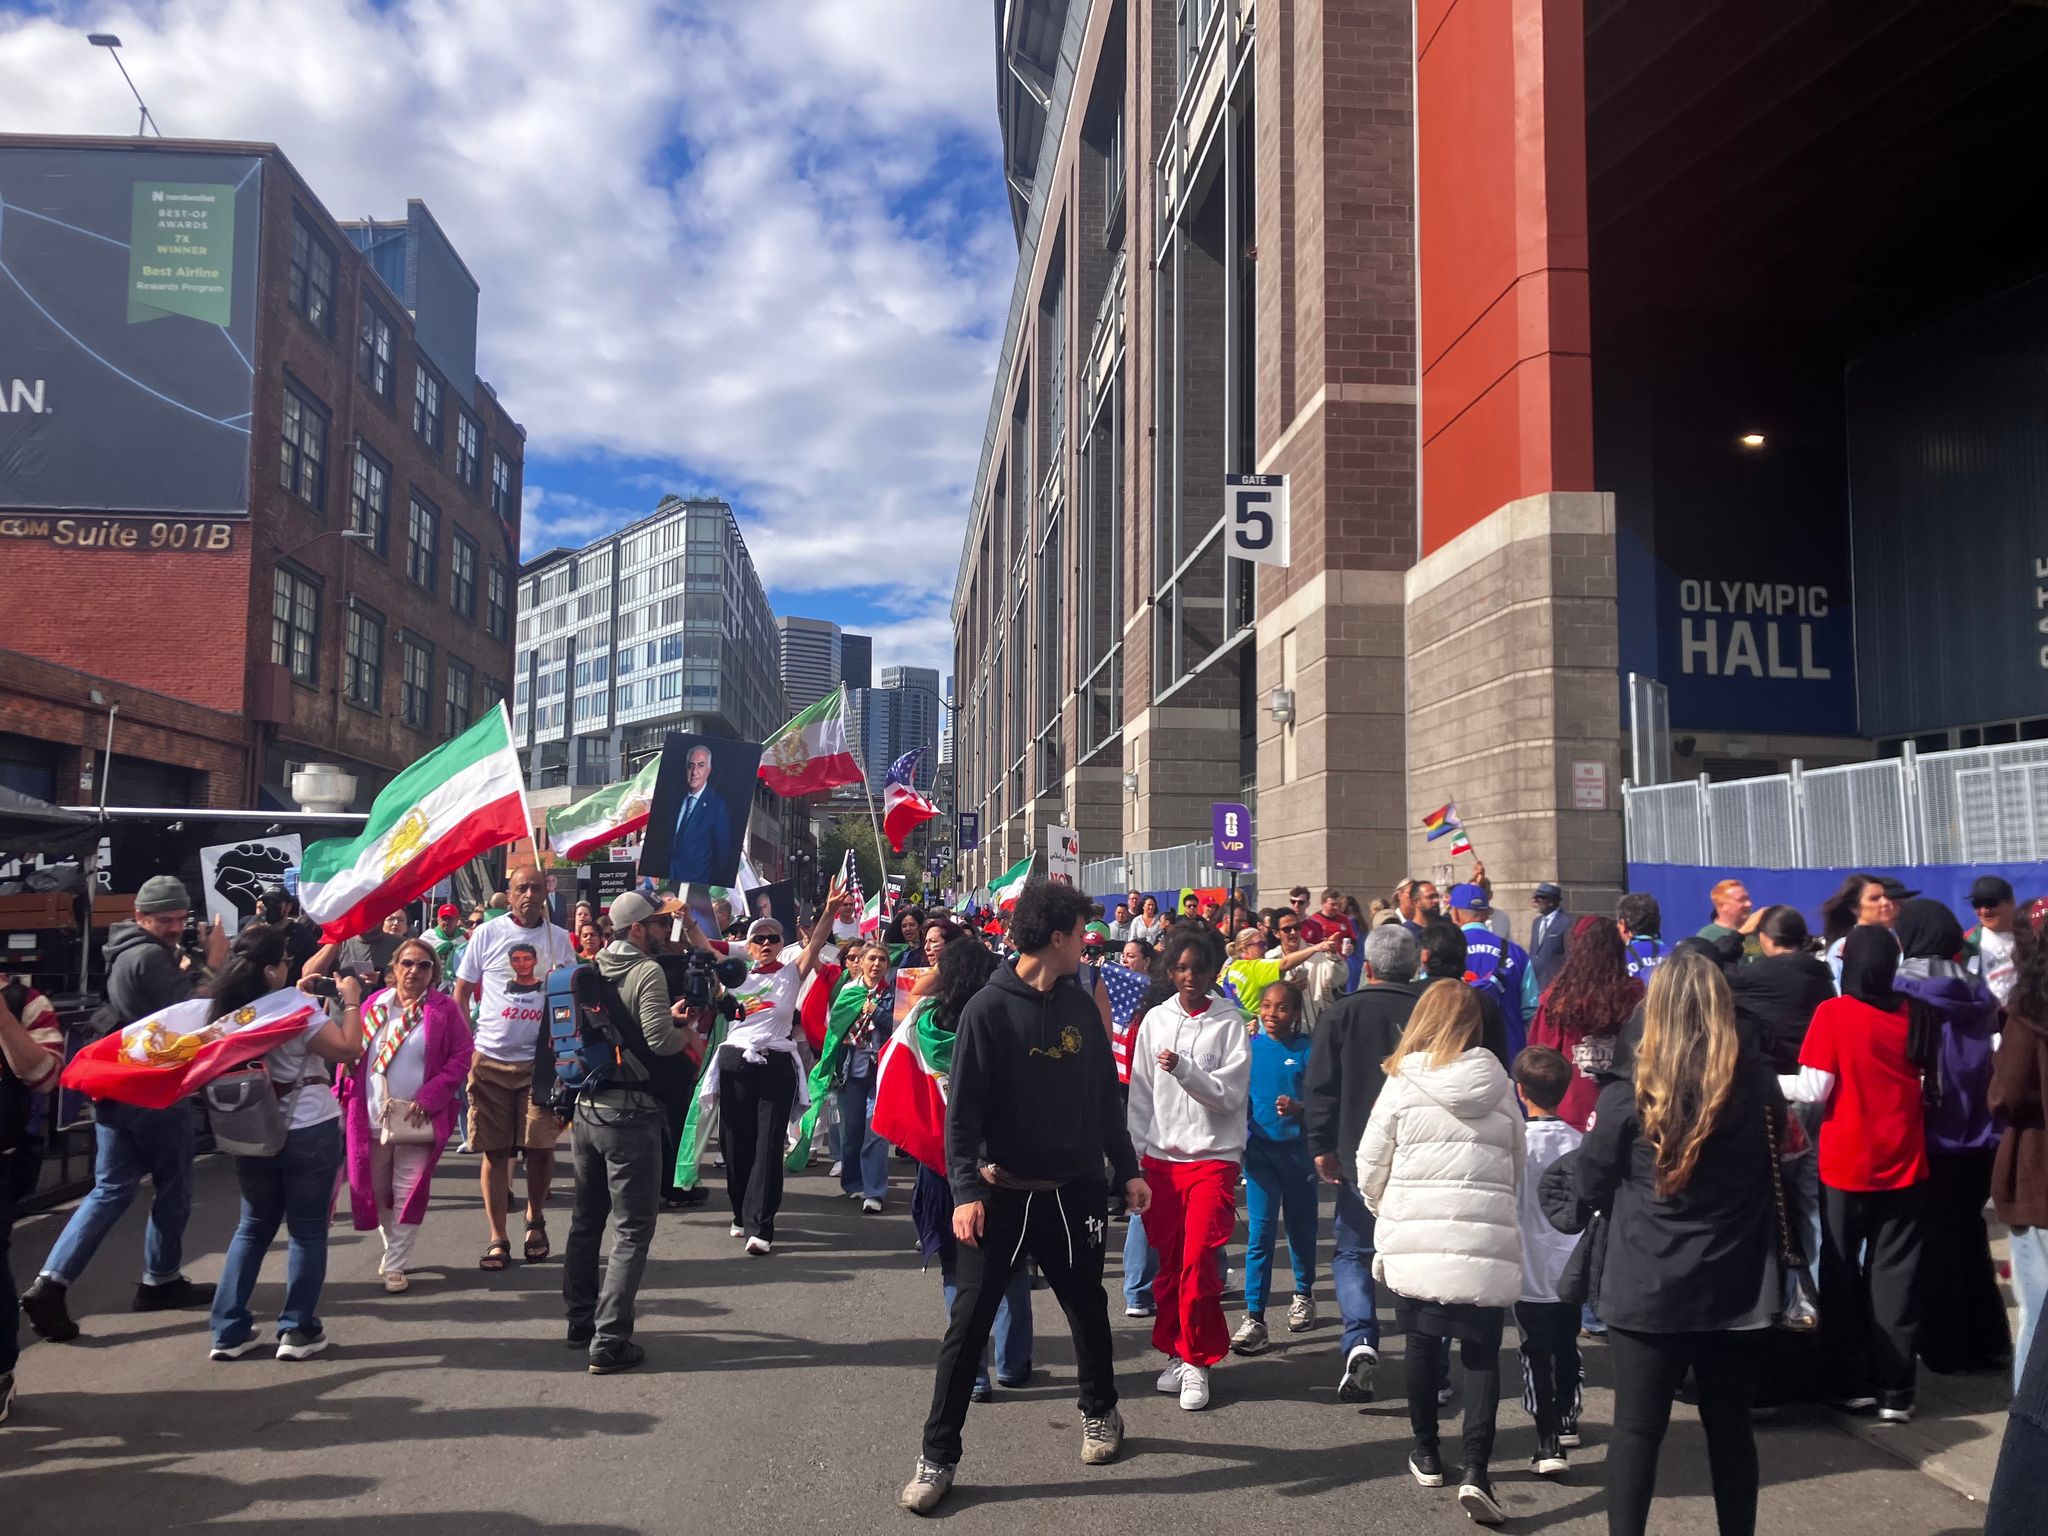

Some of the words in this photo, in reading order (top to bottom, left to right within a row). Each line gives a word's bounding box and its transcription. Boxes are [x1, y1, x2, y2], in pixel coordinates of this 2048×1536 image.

[158, 208, 208, 219] BEST-OF
[157, 220, 208, 230] AWARDS
[174, 234, 191, 244] 7X
[157, 245, 208, 256] WINNER
[142, 265, 172, 277] Best
[176, 267, 220, 279] Airline
[136, 281, 179, 292] Rewards
[181, 283, 224, 294] Program
[1241, 475, 1267, 485] GATE
[1235, 491, 1273, 550] 5
[53, 519, 139, 548] Suite
[149, 521, 232, 549] 901B
[1679, 578, 1829, 618] OLYMPIC
[1680, 617, 1832, 680] HALL
[943, 847, 950, 857] 4
[1221, 841, 1244, 851] VIP
[1466, 943, 1515, 969] UNTER
[501, 1006, 543, 1022] 42,000
